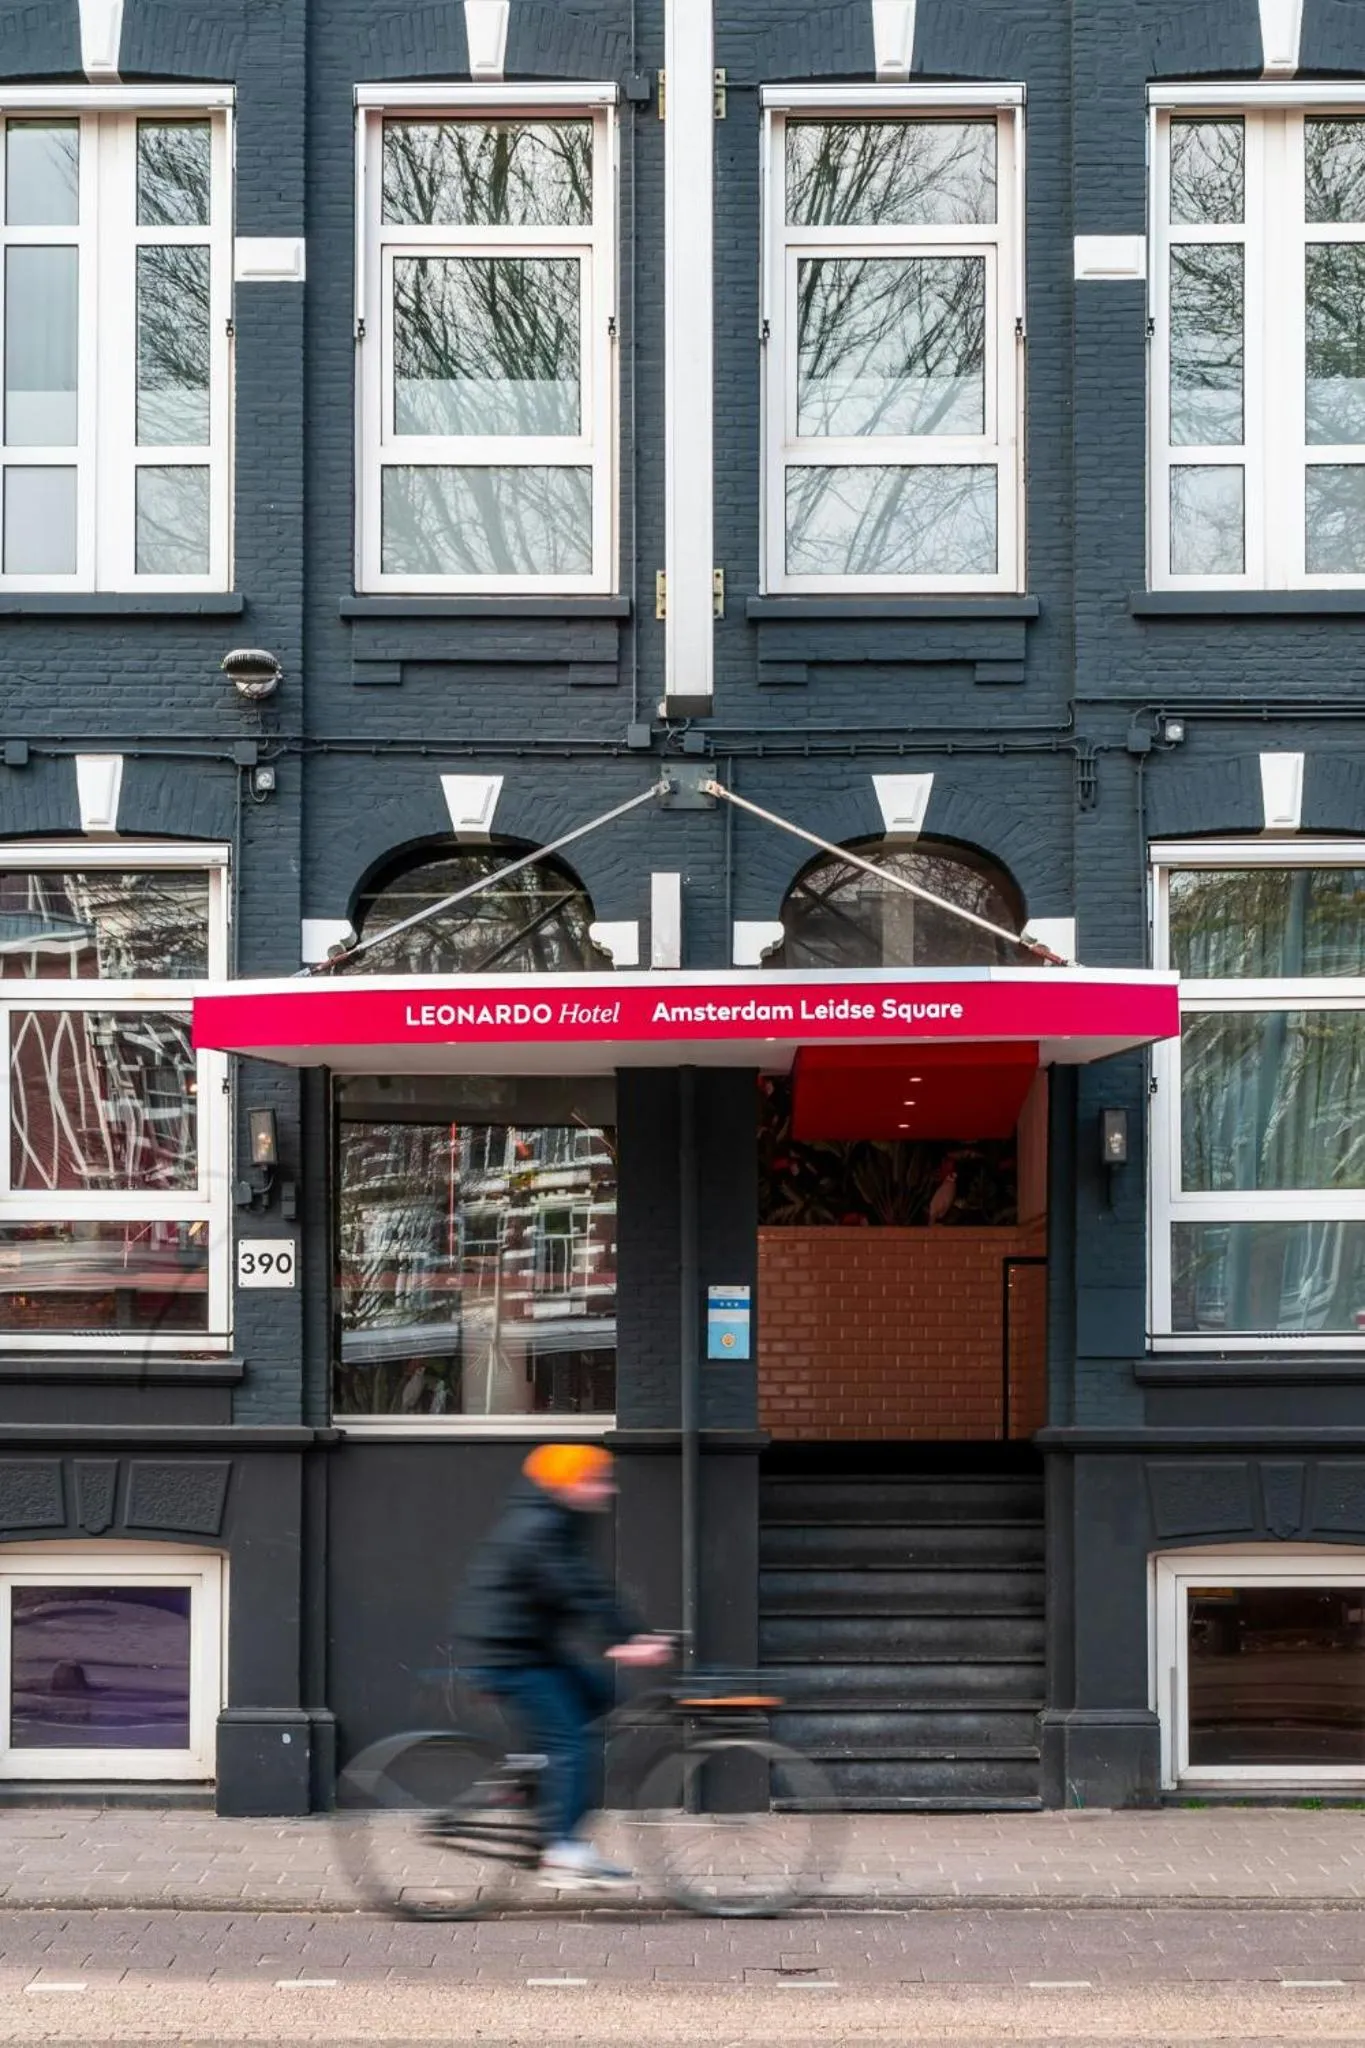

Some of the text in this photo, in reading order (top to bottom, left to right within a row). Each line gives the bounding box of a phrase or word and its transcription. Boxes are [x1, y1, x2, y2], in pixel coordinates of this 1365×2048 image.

[406, 1002, 621, 1026] LEONARDO Hotel
[651, 998, 963, 1024] Amsterdam Leidse Square
[241, 1252, 293, 1274] 390
